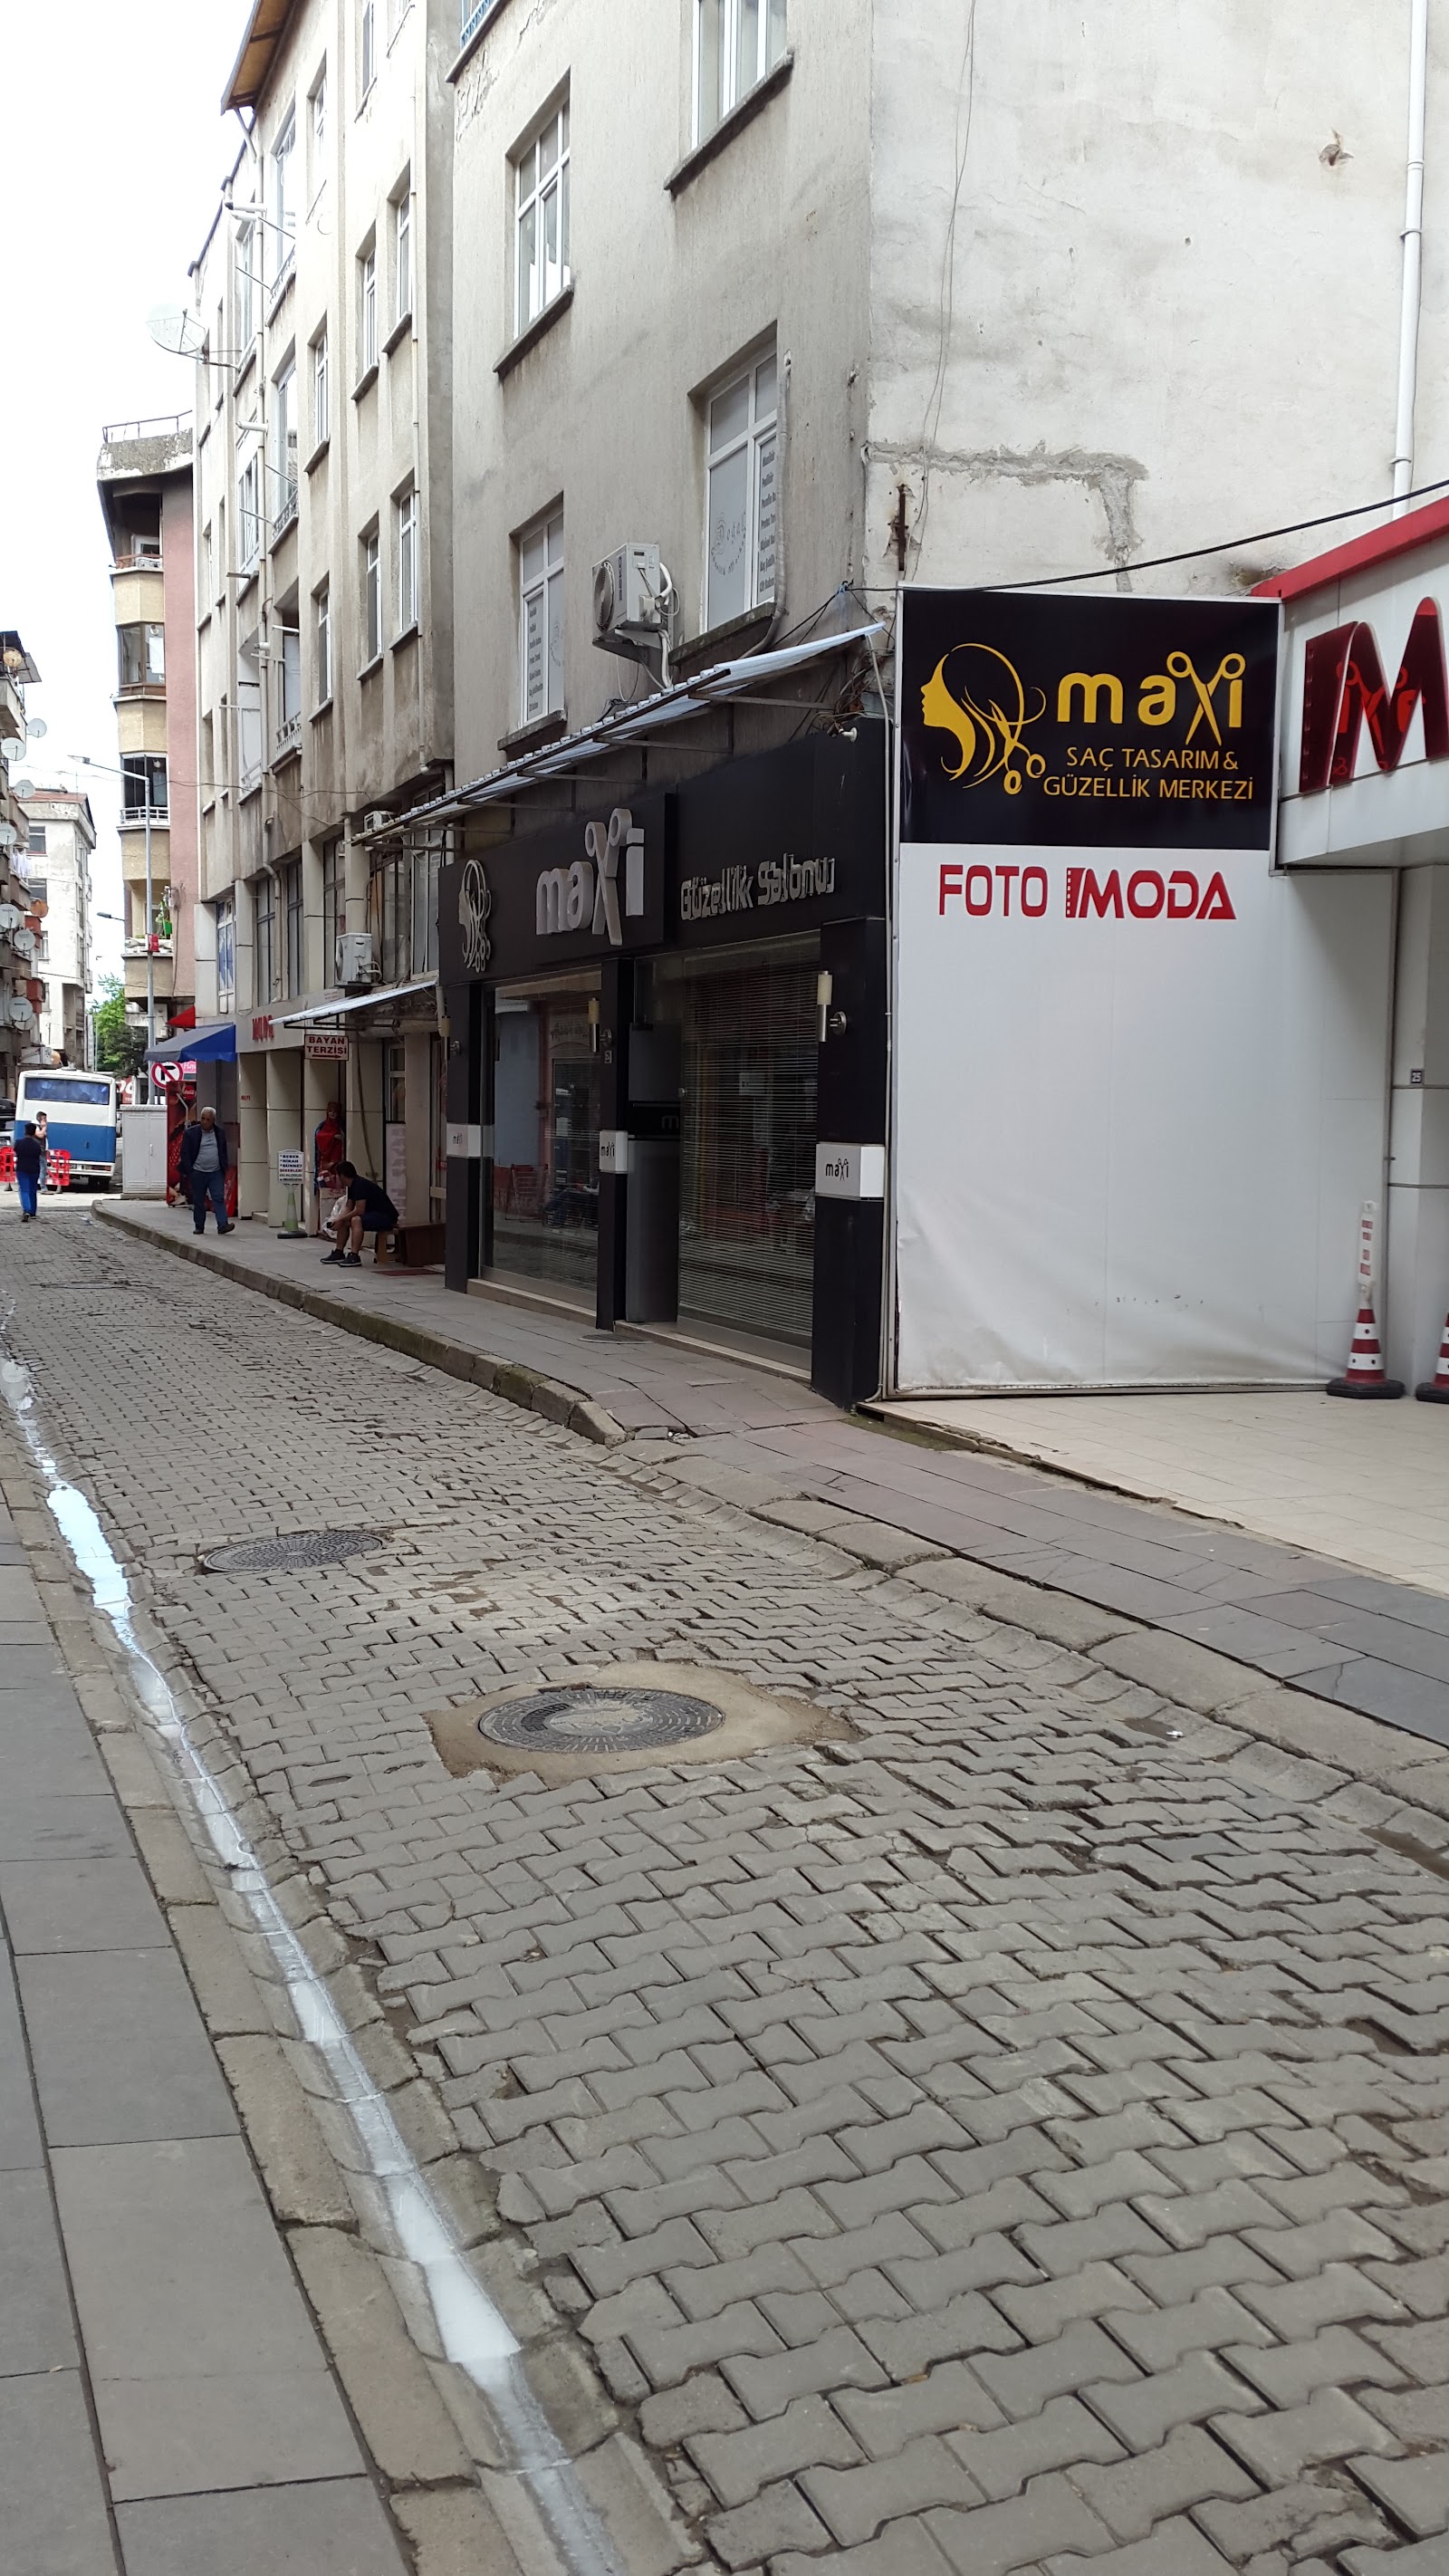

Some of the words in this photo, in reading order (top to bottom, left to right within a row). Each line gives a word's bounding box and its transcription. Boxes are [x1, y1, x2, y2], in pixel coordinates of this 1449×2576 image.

[1067, 747, 1114, 771] SAÇ
[1122, 749, 1218, 769] TASARIM
[1223, 752, 1238, 769] &
[1043, 774, 1150, 797] GÜZELLİK
[1159, 777, 1252, 799] MERKEZİ
[681, 865, 753, 920] Güzellik
[758, 853, 835, 905] Salonu
[939, 864, 1048, 917] FOTO
[1066, 868, 1236, 919] MODA
[306, 1045, 347, 1054] TERZİSİ
[309, 1036, 344, 1044] BAYAN
